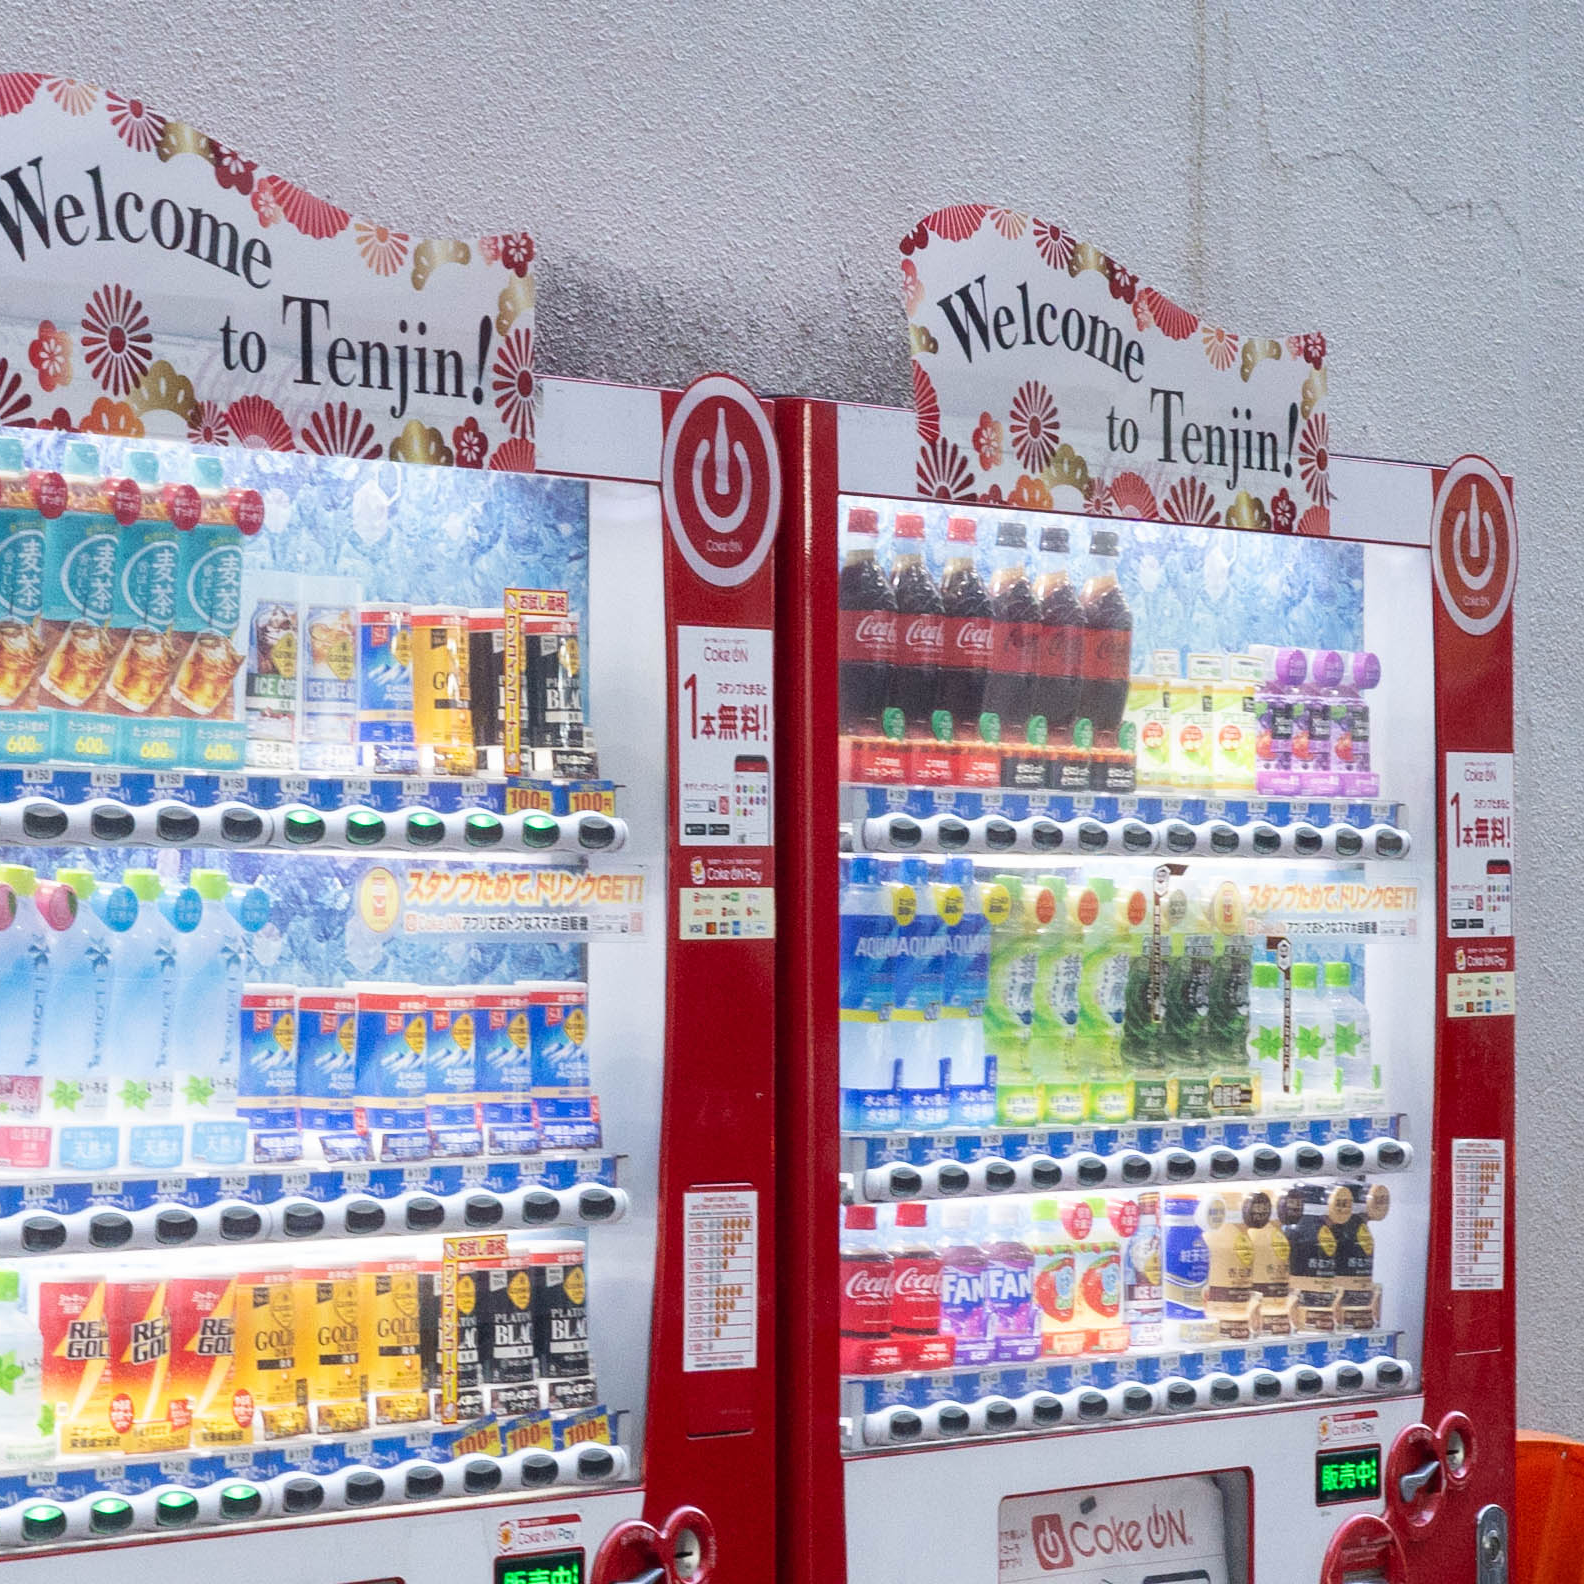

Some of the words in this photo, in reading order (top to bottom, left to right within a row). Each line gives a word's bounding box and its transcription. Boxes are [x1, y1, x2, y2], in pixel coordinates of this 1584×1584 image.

[935, 273, 1146, 383] Welcome
[218, 315, 267, 375] to
[281, 296, 495, 418] Tenjin!
[1107, 403, 1139, 454] to
[1150, 387, 1299, 490] Tenjin!
[16, 539, 45, 609] 麦茶
[90, 545, 117, 612] 麦茶
[151, 550, 177, 618] 麦茶
[215, 555, 241, 623] 麦茶
[704, 646, 730, 662] Coke
[732, 646, 749, 662] ON
[255, 677, 274, 696] ICE
[716, 682, 768, 696] スタンプたまると
[1464, 768, 1483, 782] Coke
[510, 789, 551, 810] 100円
[572, 792, 614, 813] 100円
[707, 867, 729, 882] Coke
[746, 869, 762, 885] Pay
[1322, 1462, 1372, 1492] 販売中
[1069, 1518, 1142, 1558] Coke
[1147, 1503, 1187, 1550] ON
